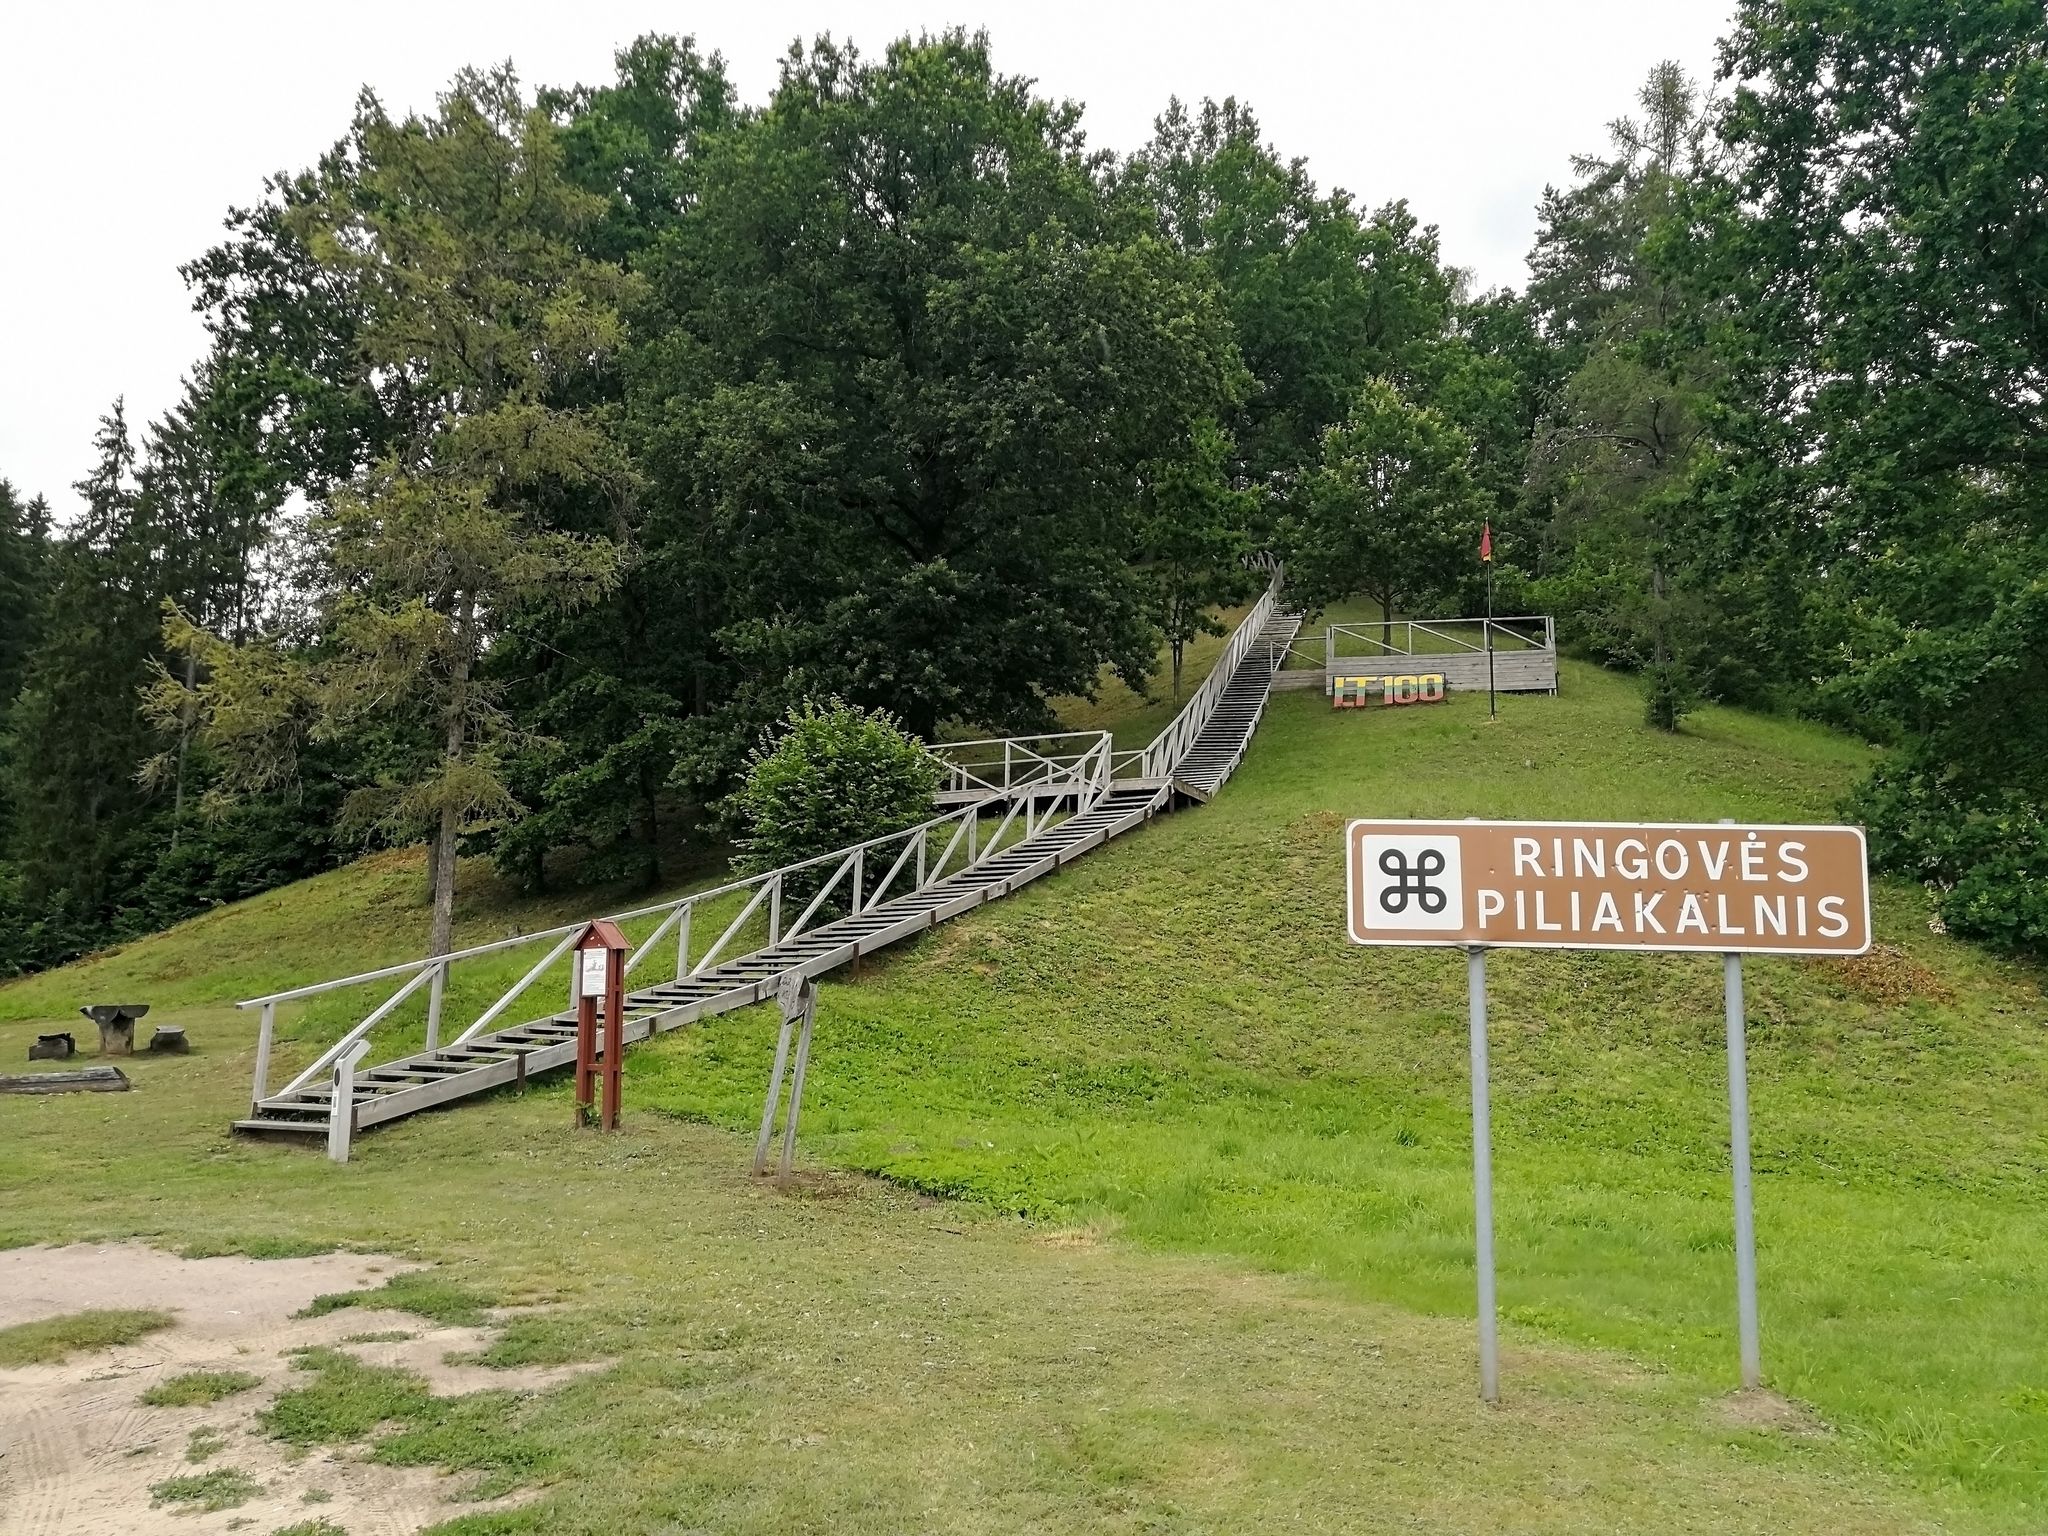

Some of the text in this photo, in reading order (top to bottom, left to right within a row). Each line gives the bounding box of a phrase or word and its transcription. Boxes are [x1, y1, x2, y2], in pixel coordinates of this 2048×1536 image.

[1334, 673, 1444, 708] LT 100
[1513, 832, 1809, 883] RINGOVĖS
[1477, 889, 1850, 938] PILIAKALNIS
